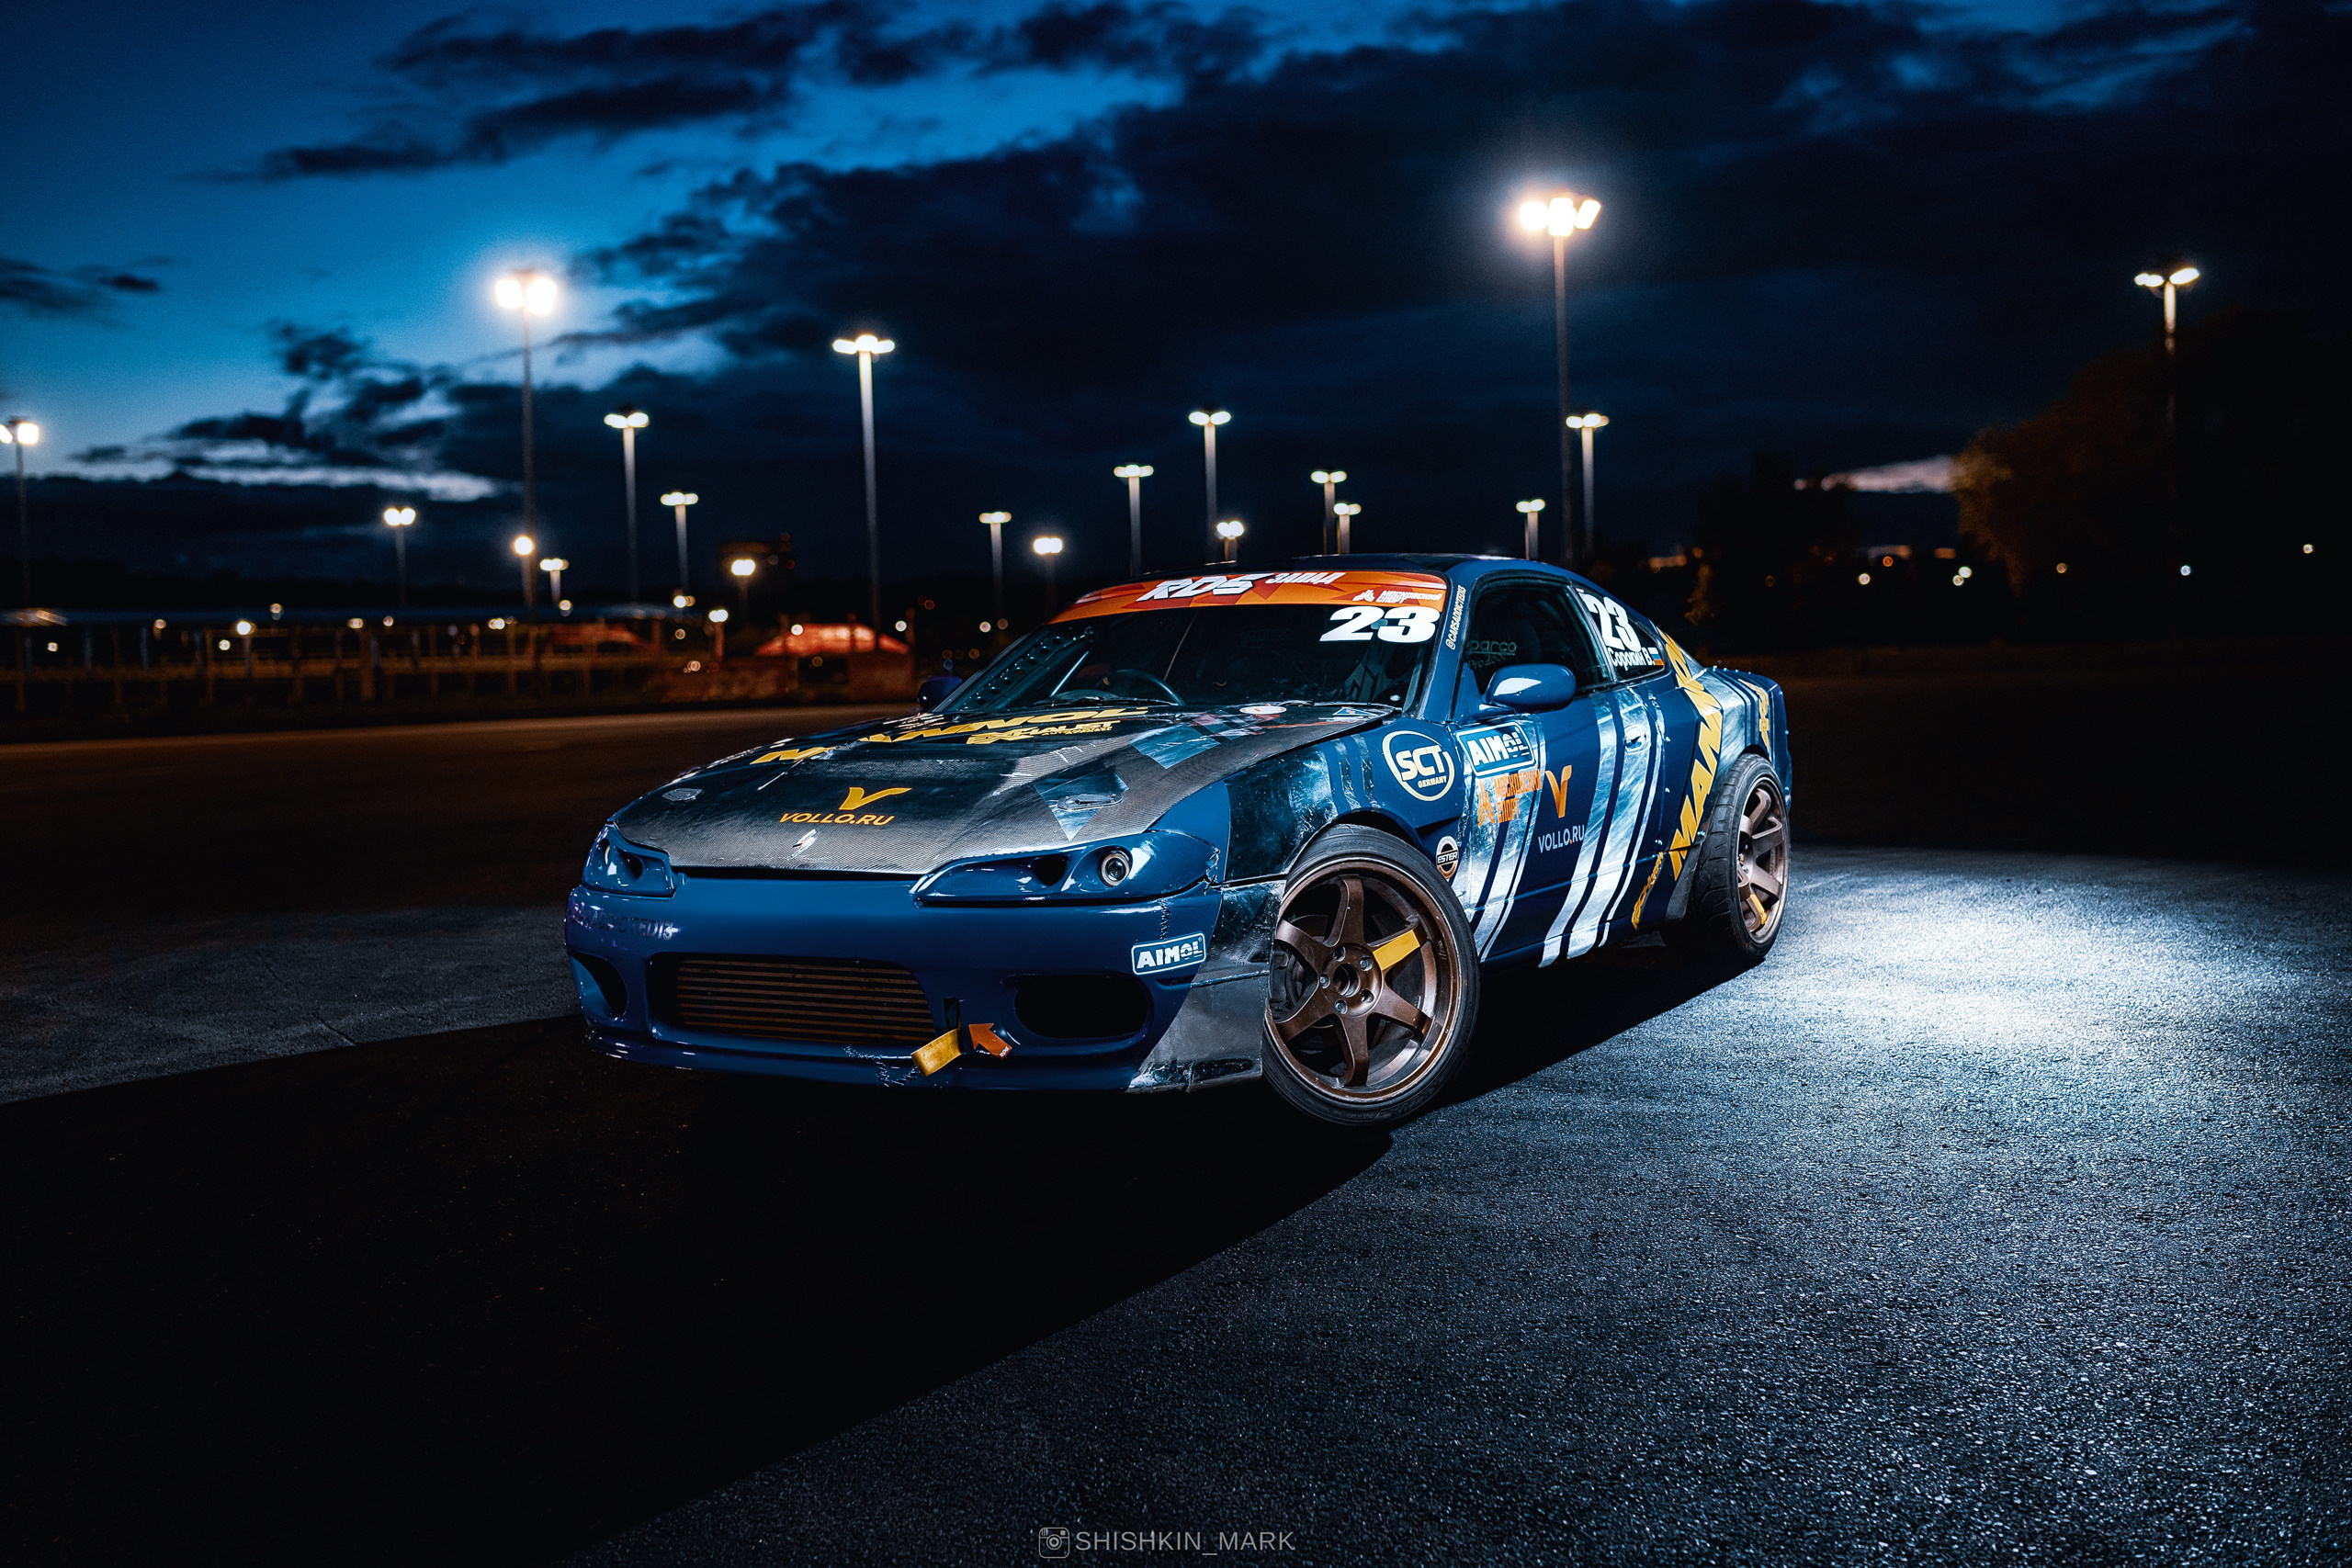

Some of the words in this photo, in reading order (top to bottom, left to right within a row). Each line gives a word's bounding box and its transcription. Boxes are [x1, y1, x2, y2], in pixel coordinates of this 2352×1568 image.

[1136, 573, 1274, 602] RDS
[1319, 606, 1441, 643] 23
[1579, 592, 1642, 652] 23
[1396, 745, 1445, 781] SCT
[1418, 775, 1447, 788] GERMANY
[779, 812, 895, 826] VOLLO.RU
[1538, 825, 1585, 852] VOLLO.RU
[1437, 852, 1458, 864] ESTER
[1136, 941, 1204, 969] AIMOL
